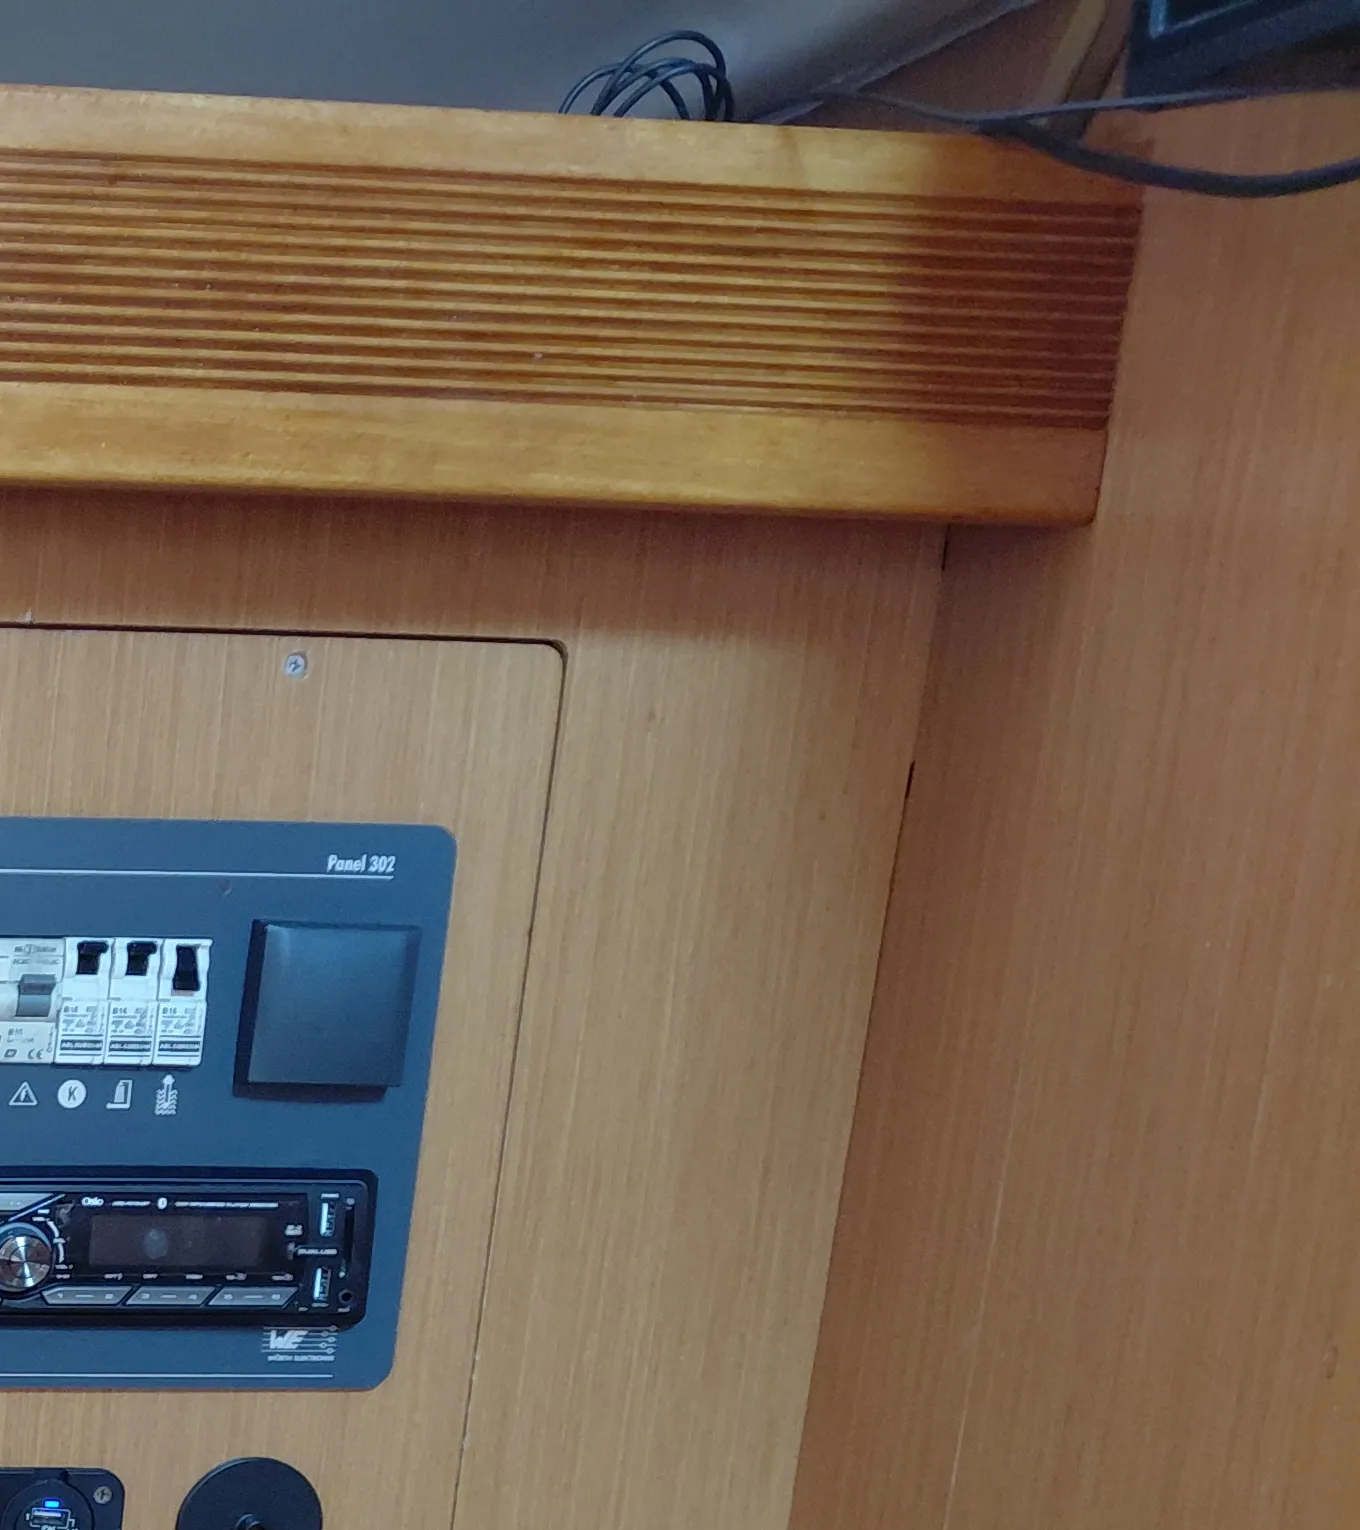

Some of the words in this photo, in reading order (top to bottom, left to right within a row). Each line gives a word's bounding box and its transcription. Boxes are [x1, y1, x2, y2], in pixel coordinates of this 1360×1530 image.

[326, 853, 368, 872] Panel
[368, 855, 397, 873] 302
[67, 1085, 79, 1102] K
